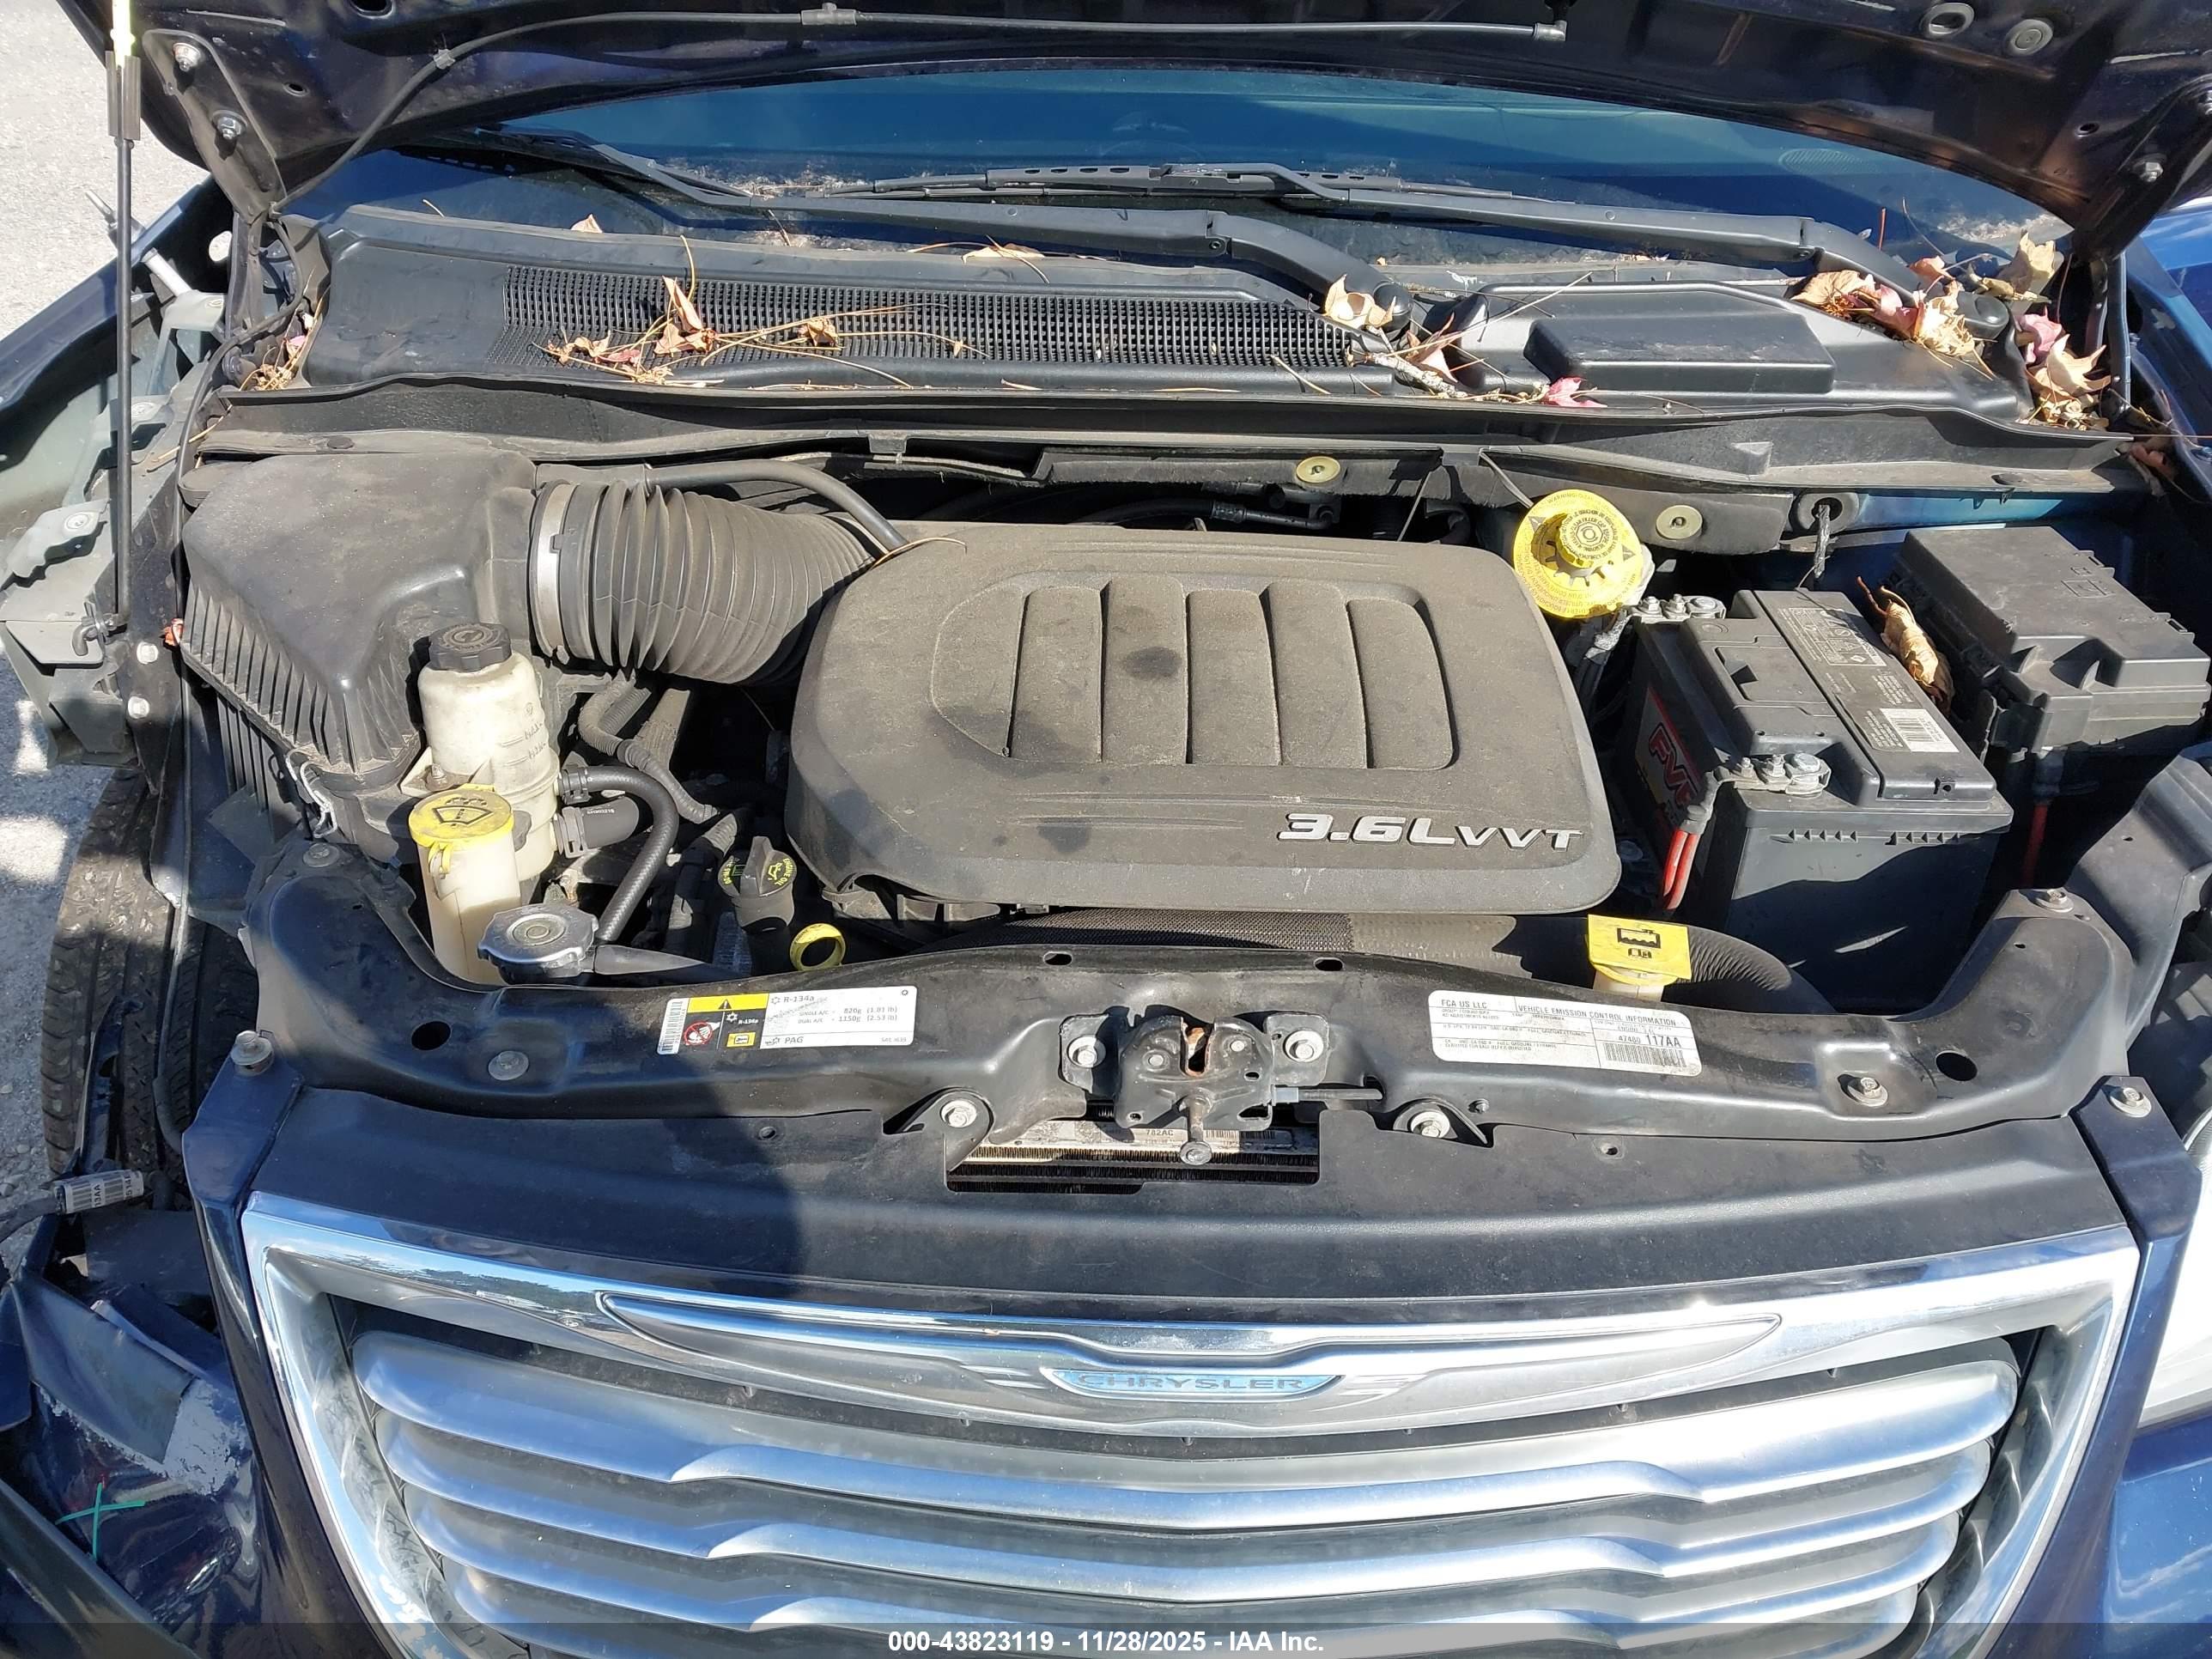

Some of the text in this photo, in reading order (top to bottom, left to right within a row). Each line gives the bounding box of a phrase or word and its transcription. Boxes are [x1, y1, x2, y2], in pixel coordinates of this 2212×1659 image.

[1277, 812, 1584, 851] 3.6L VVT
[774, 857, 794, 886] ENGINE OIL
[782, 994, 815, 1003] R-134a
[1441, 999, 1488, 1010] FCA US LLC
[1518, 1005, 1550, 1014] VEHICLE
[1551, 1007, 1587, 1018] EMISSION
[1589, 1012, 1623, 1021] CONTROL
[1626, 1015, 1676, 1027] INFORMATION
[784, 1036, 805, 1044] PAG
[1646, 1035, 1682, 1048] 117AA
[1075, 1374, 1304, 1391] CHRYSLER
